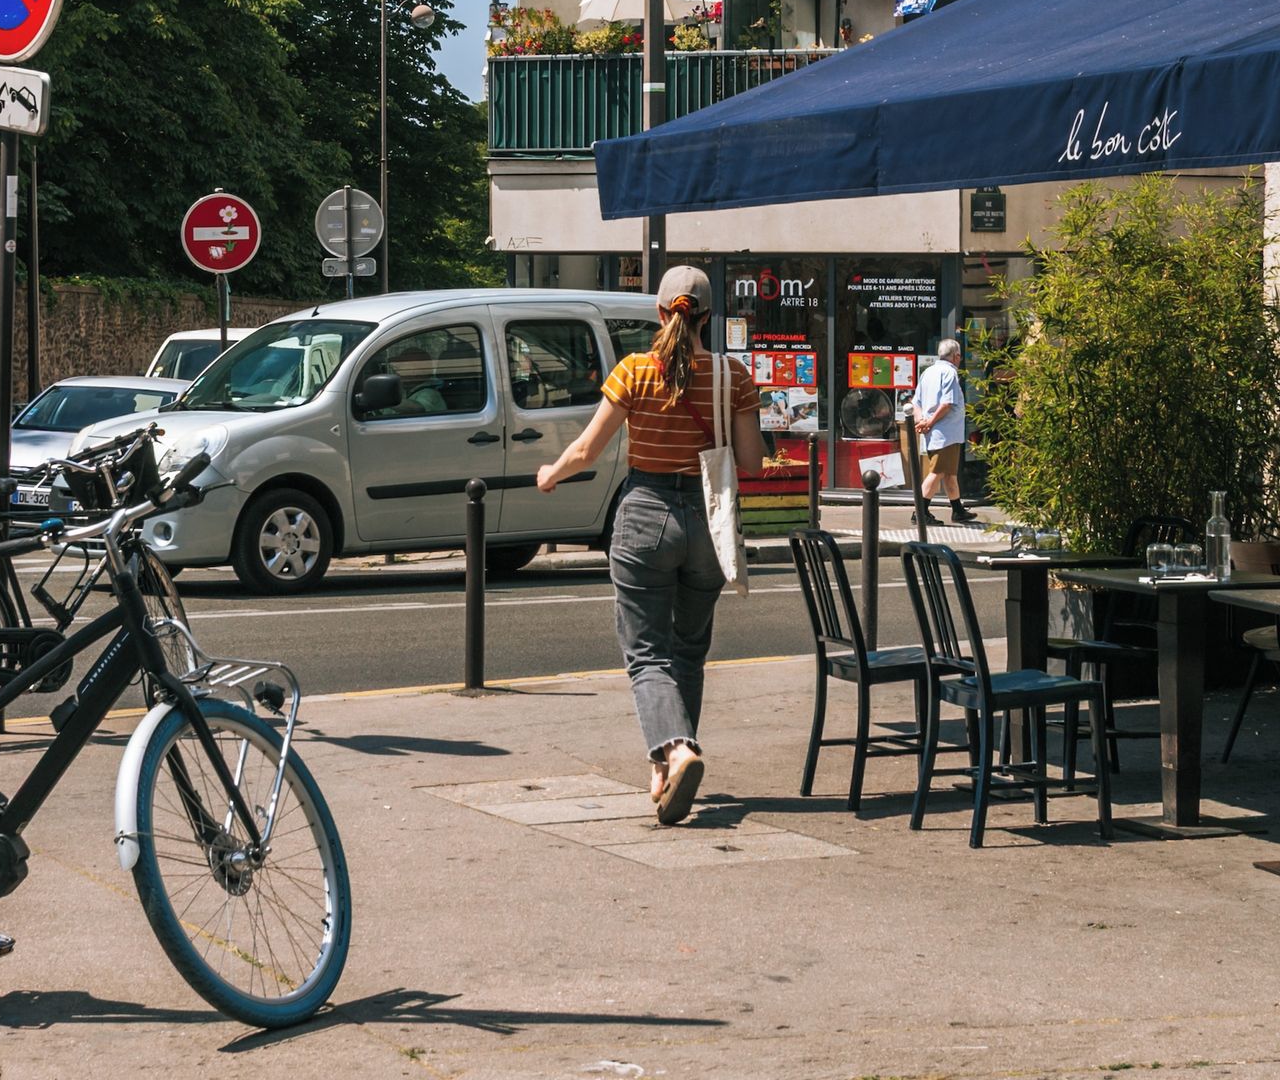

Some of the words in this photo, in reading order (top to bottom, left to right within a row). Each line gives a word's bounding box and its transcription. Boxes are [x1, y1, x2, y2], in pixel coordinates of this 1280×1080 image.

[1058, 108, 1085, 163] le
[1089, 101, 1132, 160] bon
[780, 297, 805, 307] ARTRE
[808, 298, 819, 307] 18
[763, 334, 807, 342] PROGRAMME
